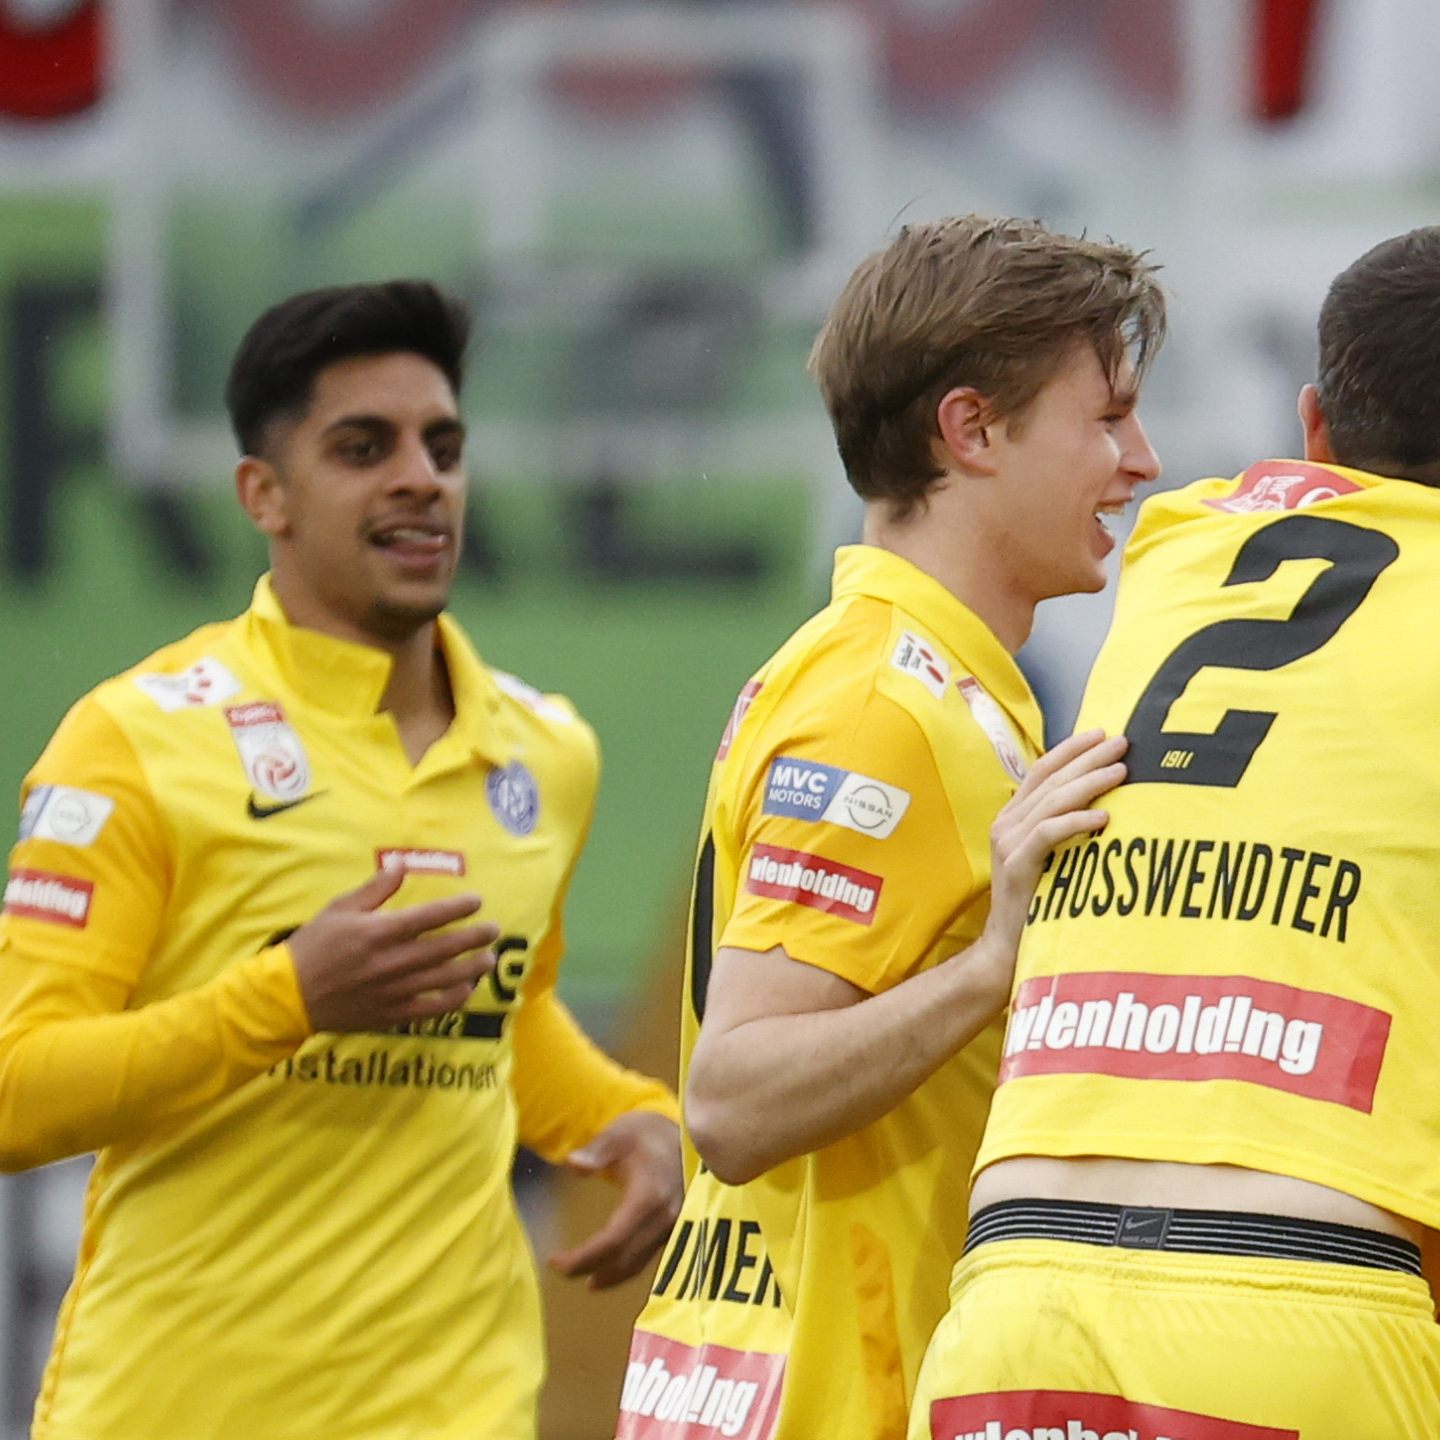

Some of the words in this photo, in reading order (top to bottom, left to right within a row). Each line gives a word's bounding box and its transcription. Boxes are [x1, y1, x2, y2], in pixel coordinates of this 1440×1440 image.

[1124, 514, 1400, 788] 2
[1160, 750, 1195, 769] 1911
[771, 764, 829, 794] MVC
[768, 788, 823, 810] MOTORS
[843, 795, 893, 819] NISSAN
